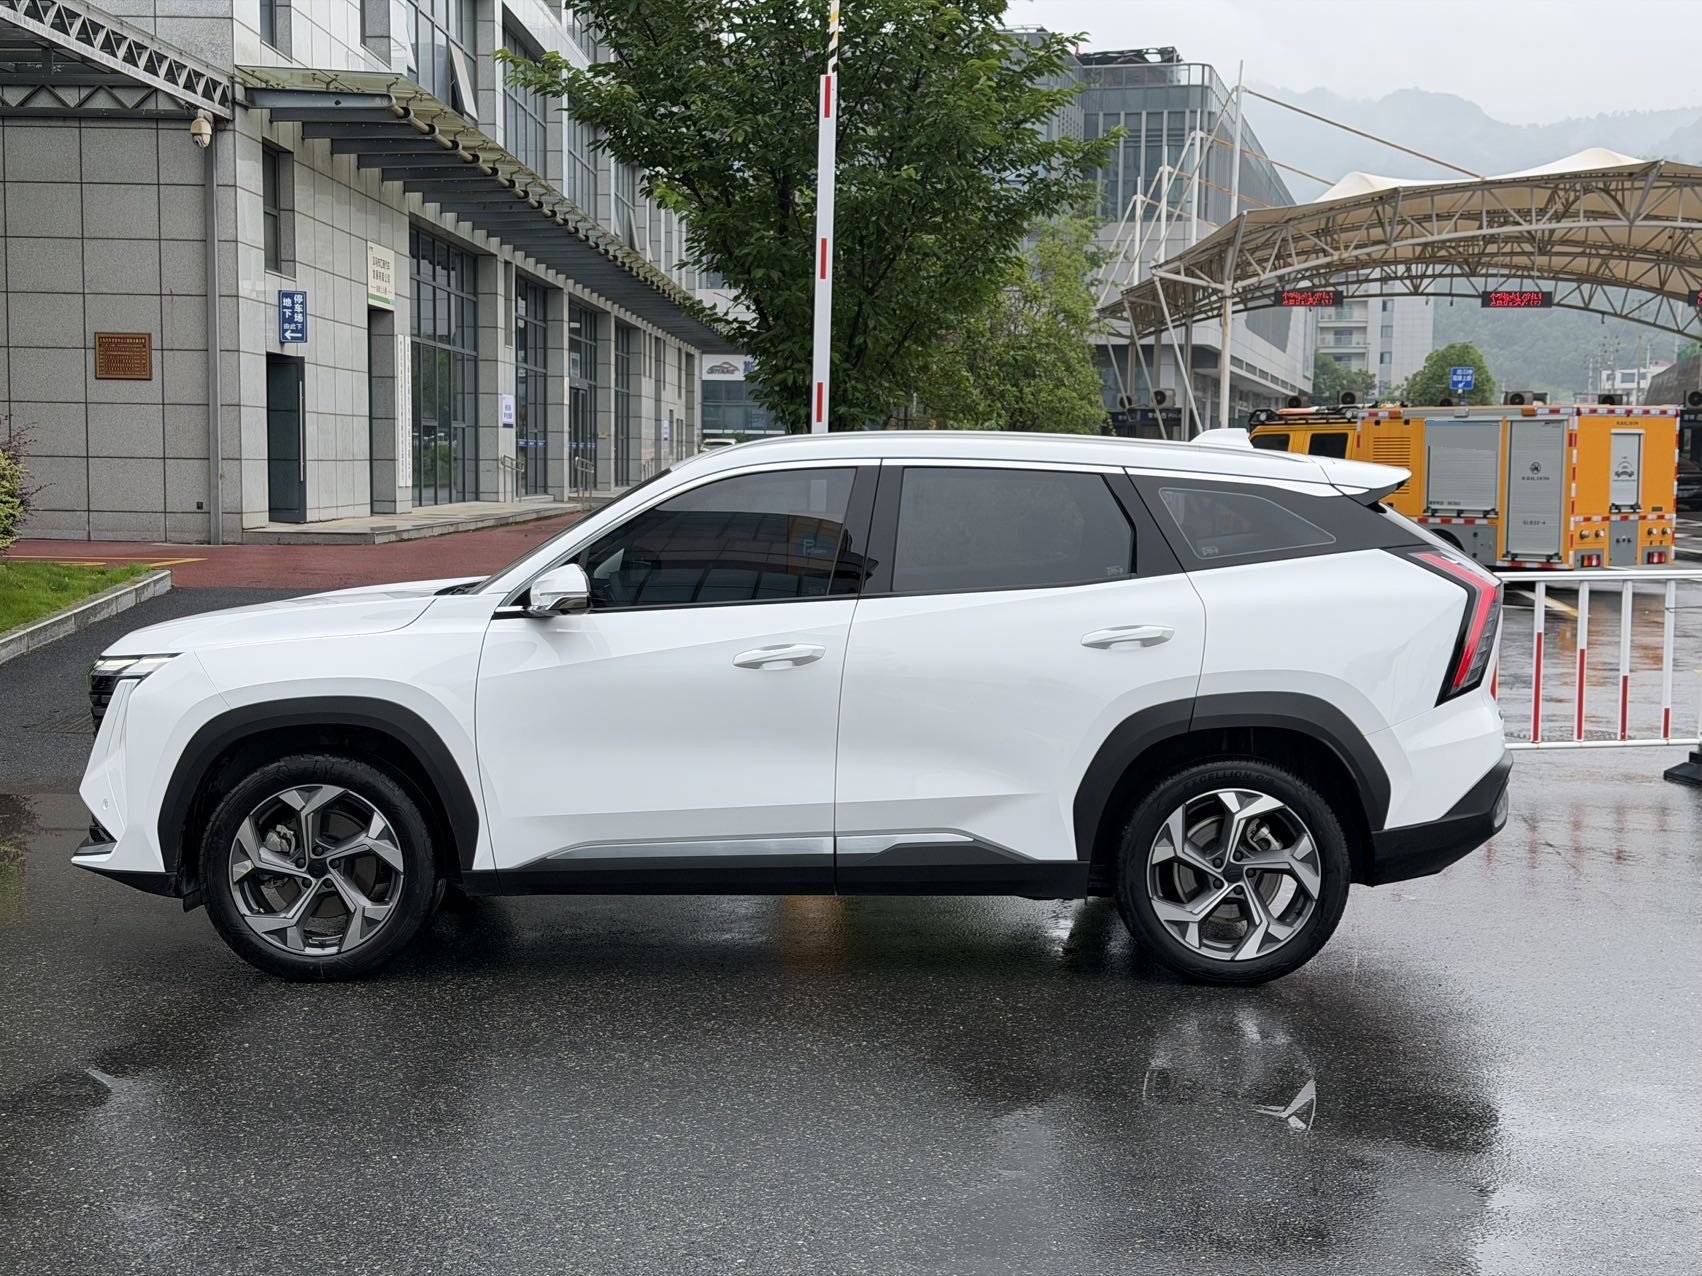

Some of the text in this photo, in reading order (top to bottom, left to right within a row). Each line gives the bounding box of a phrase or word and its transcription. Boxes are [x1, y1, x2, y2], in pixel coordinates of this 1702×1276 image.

[283, 297, 292, 318] 地下
[294, 294, 303, 322] 停车场
